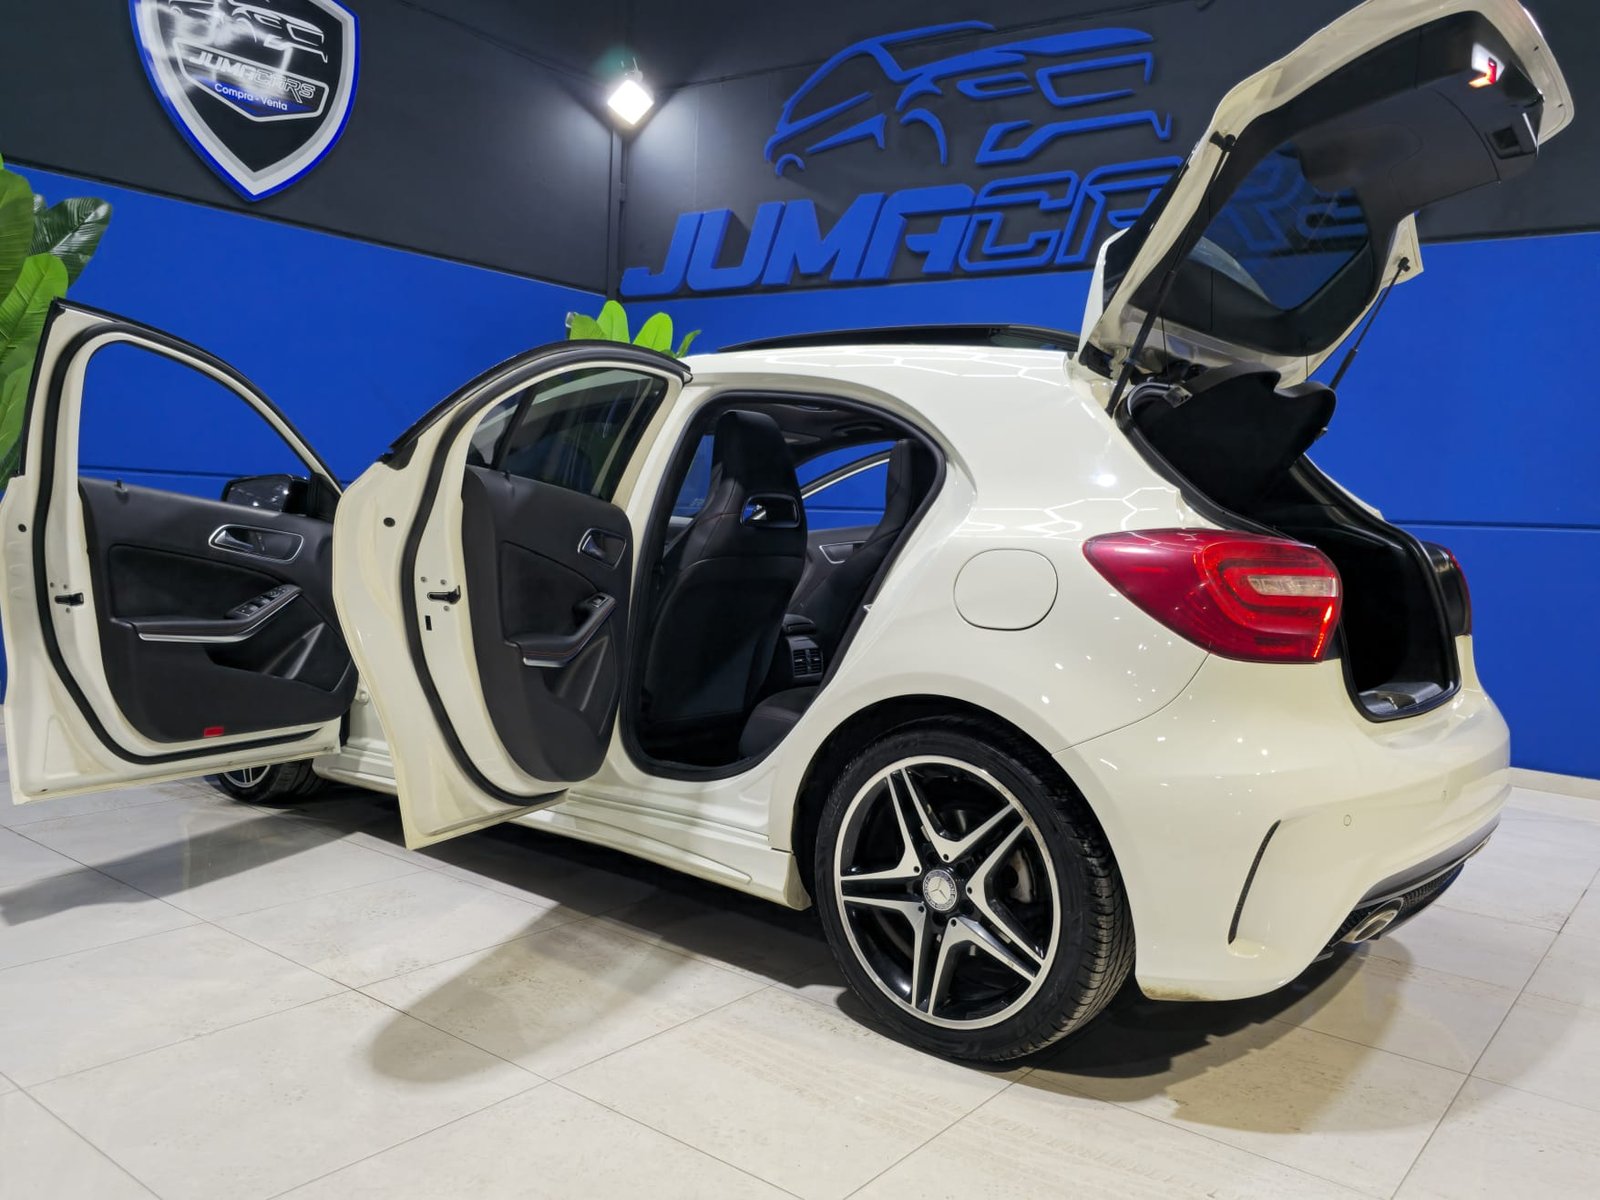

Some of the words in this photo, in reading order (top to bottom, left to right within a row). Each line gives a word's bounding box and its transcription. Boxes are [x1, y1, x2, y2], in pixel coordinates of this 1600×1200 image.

[188, 51, 316, 104] JUMACARS
[214, 83, 254, 102] Compra
[261, 96, 288, 111] Venta
